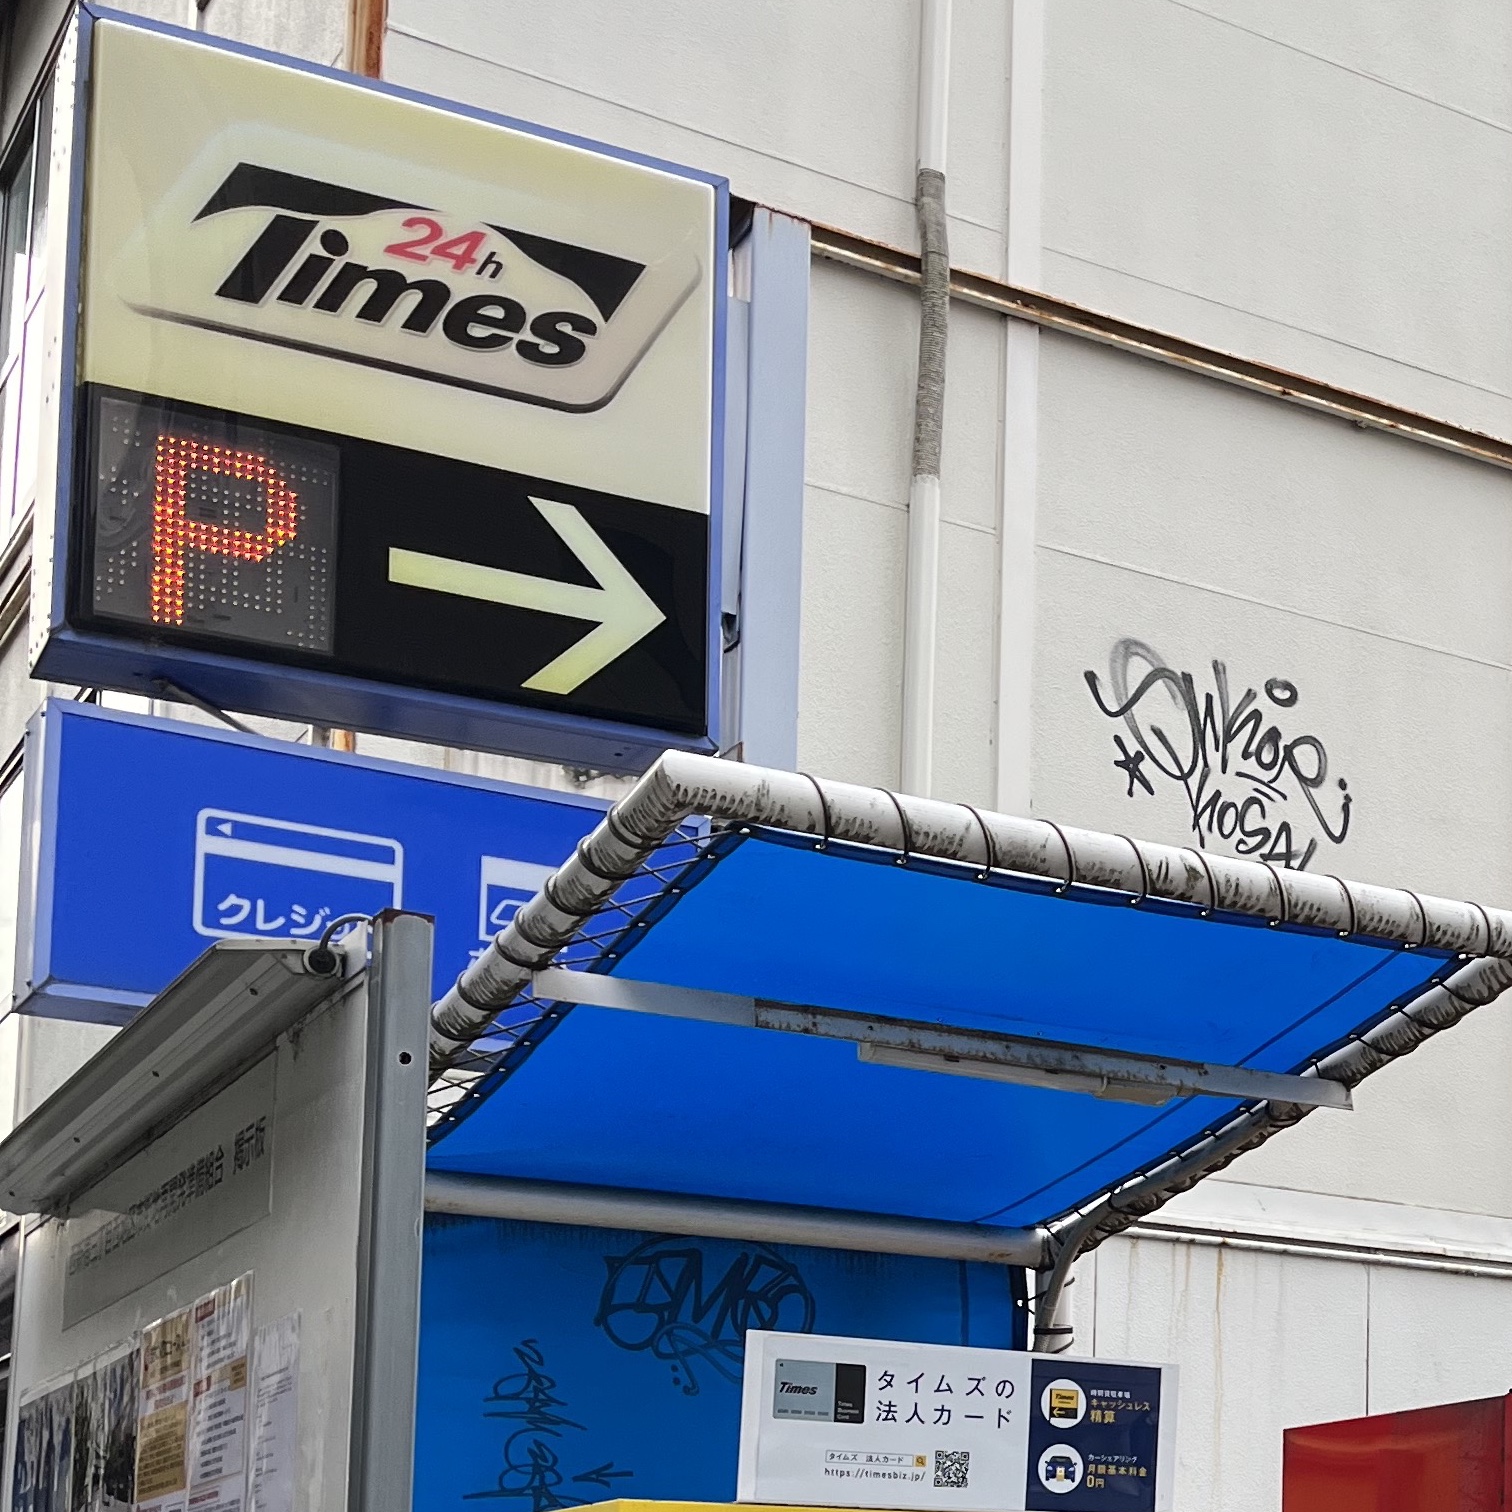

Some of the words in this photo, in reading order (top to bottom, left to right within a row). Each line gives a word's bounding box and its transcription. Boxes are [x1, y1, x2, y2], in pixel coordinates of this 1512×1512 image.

[384, 216, 503, 280] 24h
[195, 185, 602, 369] Times
[152, 434, 298, 625] P
[217, 893, 345, 940] クレジ
[779, 1381, 818, 1396] Times
[877, 1370, 1015, 1399] タイムズの
[876, 1400, 1013, 1429] 法人カード
[828, 1452, 858, 1462] タイムズ
[824, 1467, 926, 1482] https://timesbiz.jp/
